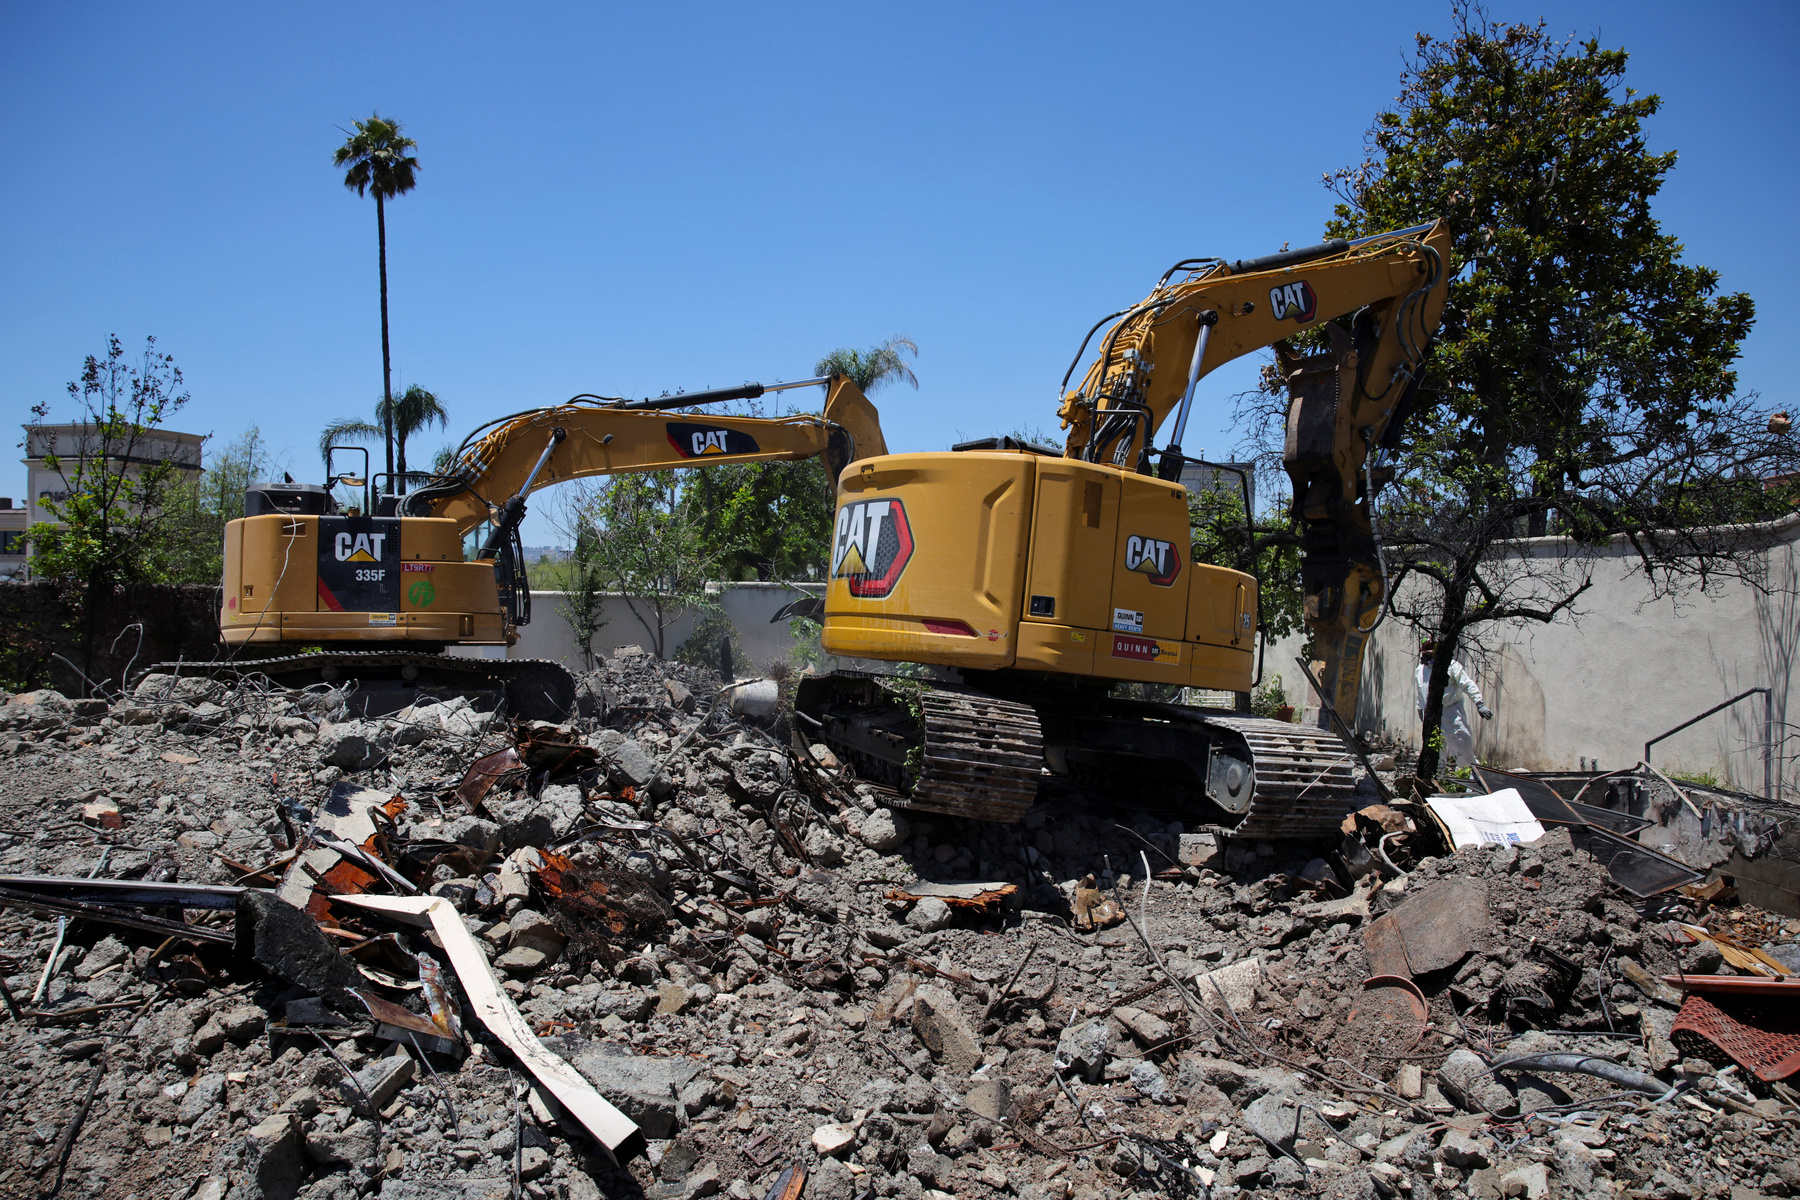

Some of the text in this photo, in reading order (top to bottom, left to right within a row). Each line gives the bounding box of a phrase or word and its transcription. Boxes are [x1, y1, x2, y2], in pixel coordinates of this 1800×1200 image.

[1270, 281, 1306, 320] CAT
[691, 430, 728, 455] CAT
[335, 532, 386, 562] CAT
[831, 501, 891, 576] CAT
[1126, 535, 1170, 575] CAT
[355, 569, 386, 581] 335F
[1114, 622, 1142, 633] HEAVY RENTS
[1117, 612, 1135, 621] QUINN
[1117, 642, 1178, 657] QUINN CAT Rental
